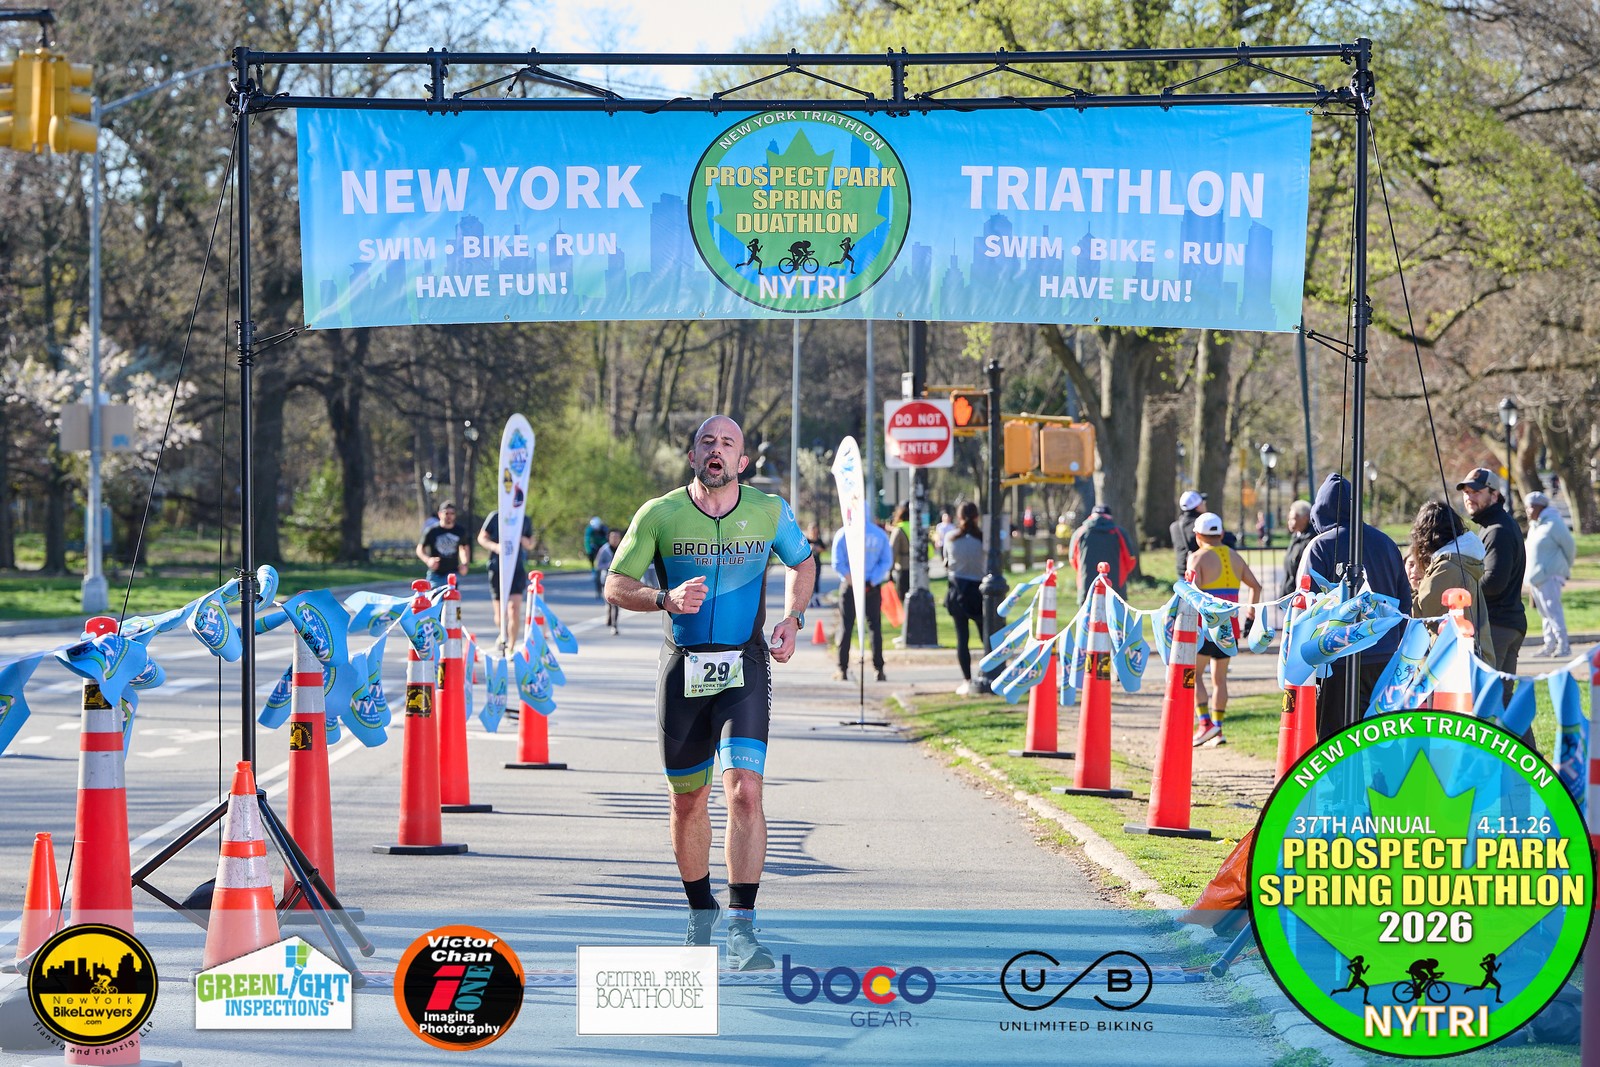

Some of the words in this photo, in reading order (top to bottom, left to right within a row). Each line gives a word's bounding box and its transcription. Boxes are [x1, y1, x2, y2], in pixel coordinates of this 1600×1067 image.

[718, 124, 752, 150] NEW
[753, 110, 797, 128] YORK
[802, 110, 885, 151] TRIATHLON
[705, 166, 829, 187] PROSPECT
[833, 166, 897, 187] PARK
[341, 168, 470, 215] NEW
[483, 164, 644, 211] YORK
[752, 189, 842, 210] SPRING
[960, 164, 1265, 219] TRIATHLON
[736, 213, 858, 234] DUATHLON
[358, 236, 436, 261] SWIM
[463, 234, 530, 258] BIKE
[555, 232, 617, 256] RUN
[984, 235, 1063, 259] SWIM
[1090, 238, 1157, 262] BIKE
[1182, 241, 1245, 266] RUN
[415, 273, 492, 298] HAVE
[498, 271, 569, 296] FUN!
[759, 275, 846, 299] NYTRI
[1039, 275, 1114, 300] HAVE
[1122, 277, 1193, 303] FUN!
[895, 414, 912, 426] DO
[918, 413, 941, 425] NOT
[900, 442, 938, 454] ENTER
[673, 540, 765, 556] BROOKLYN
[694, 557, 712, 565] TRI
[717, 556, 745, 565] CLUB
[703, 662, 730, 682] 29
